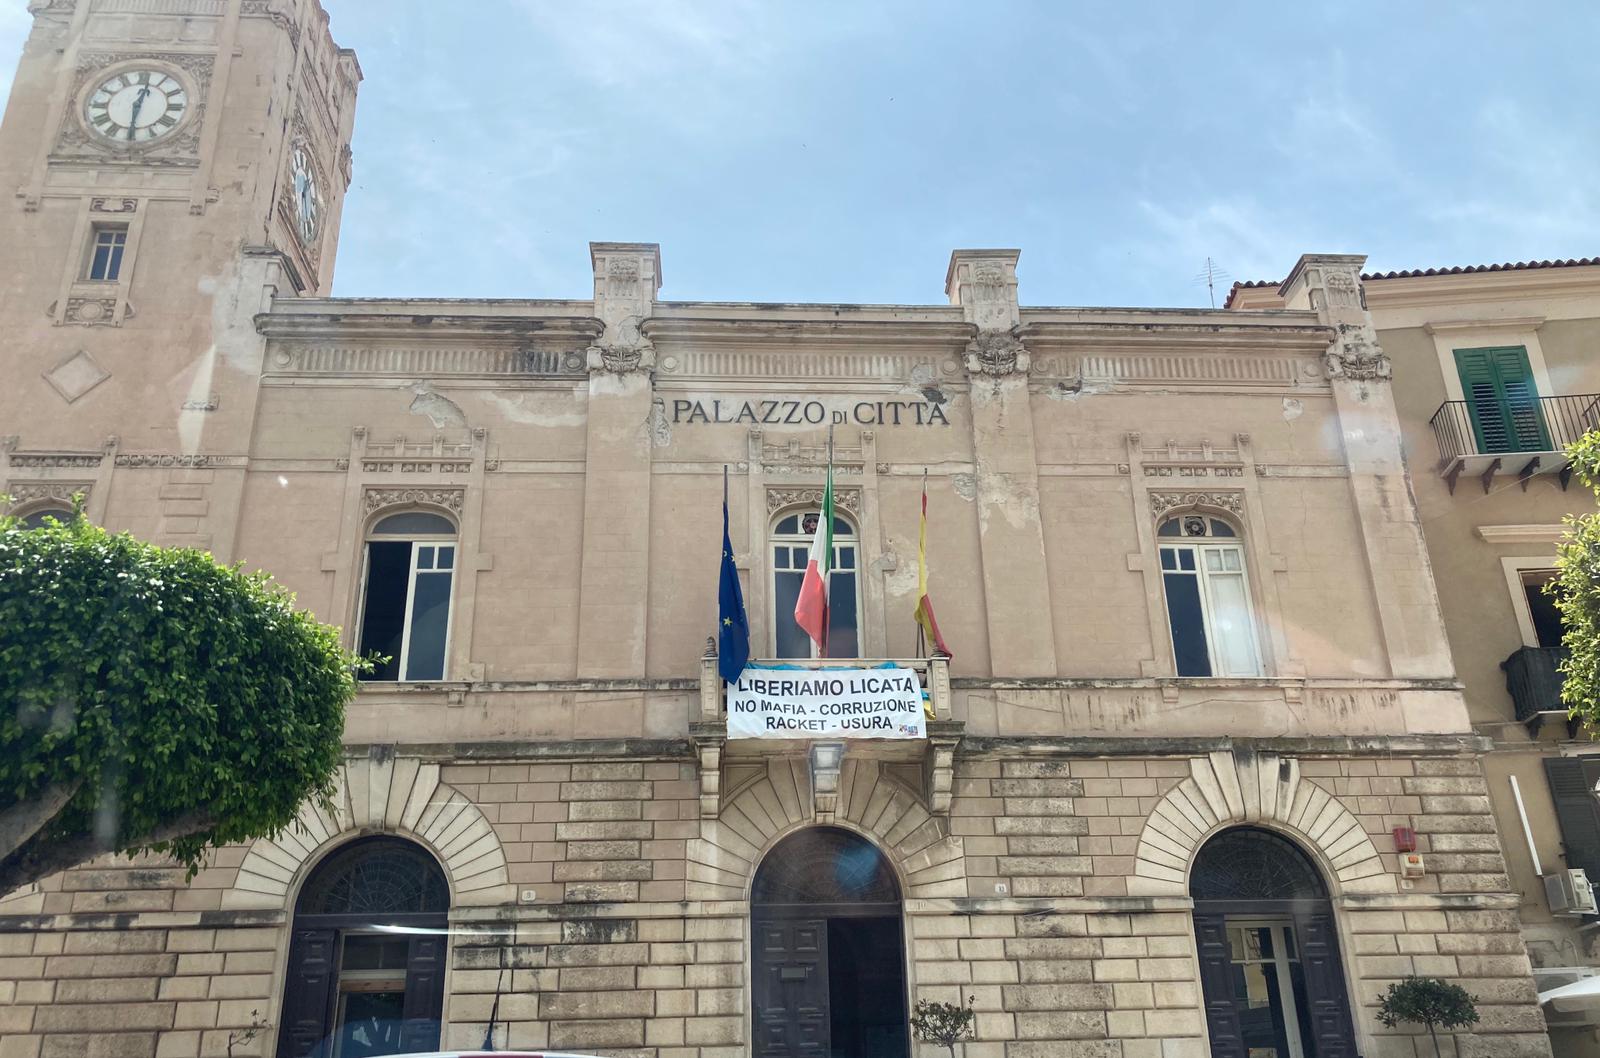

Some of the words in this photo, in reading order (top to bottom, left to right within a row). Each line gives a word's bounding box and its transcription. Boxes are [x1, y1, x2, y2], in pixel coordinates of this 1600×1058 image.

[672, 399, 825, 424] PALAZZO
[832, 410, 848, 425] DI
[738, 678, 844, 696] LIBERIAMO
[850, 677, 915, 694] LICATA
[735, 699, 757, 713] NO
[760, 699, 807, 716] MAFIA
[819, 698, 917, 716] CORRUZIONE
[766, 716, 827, 731] RACKET
[841, 715, 893, 730] USURA
